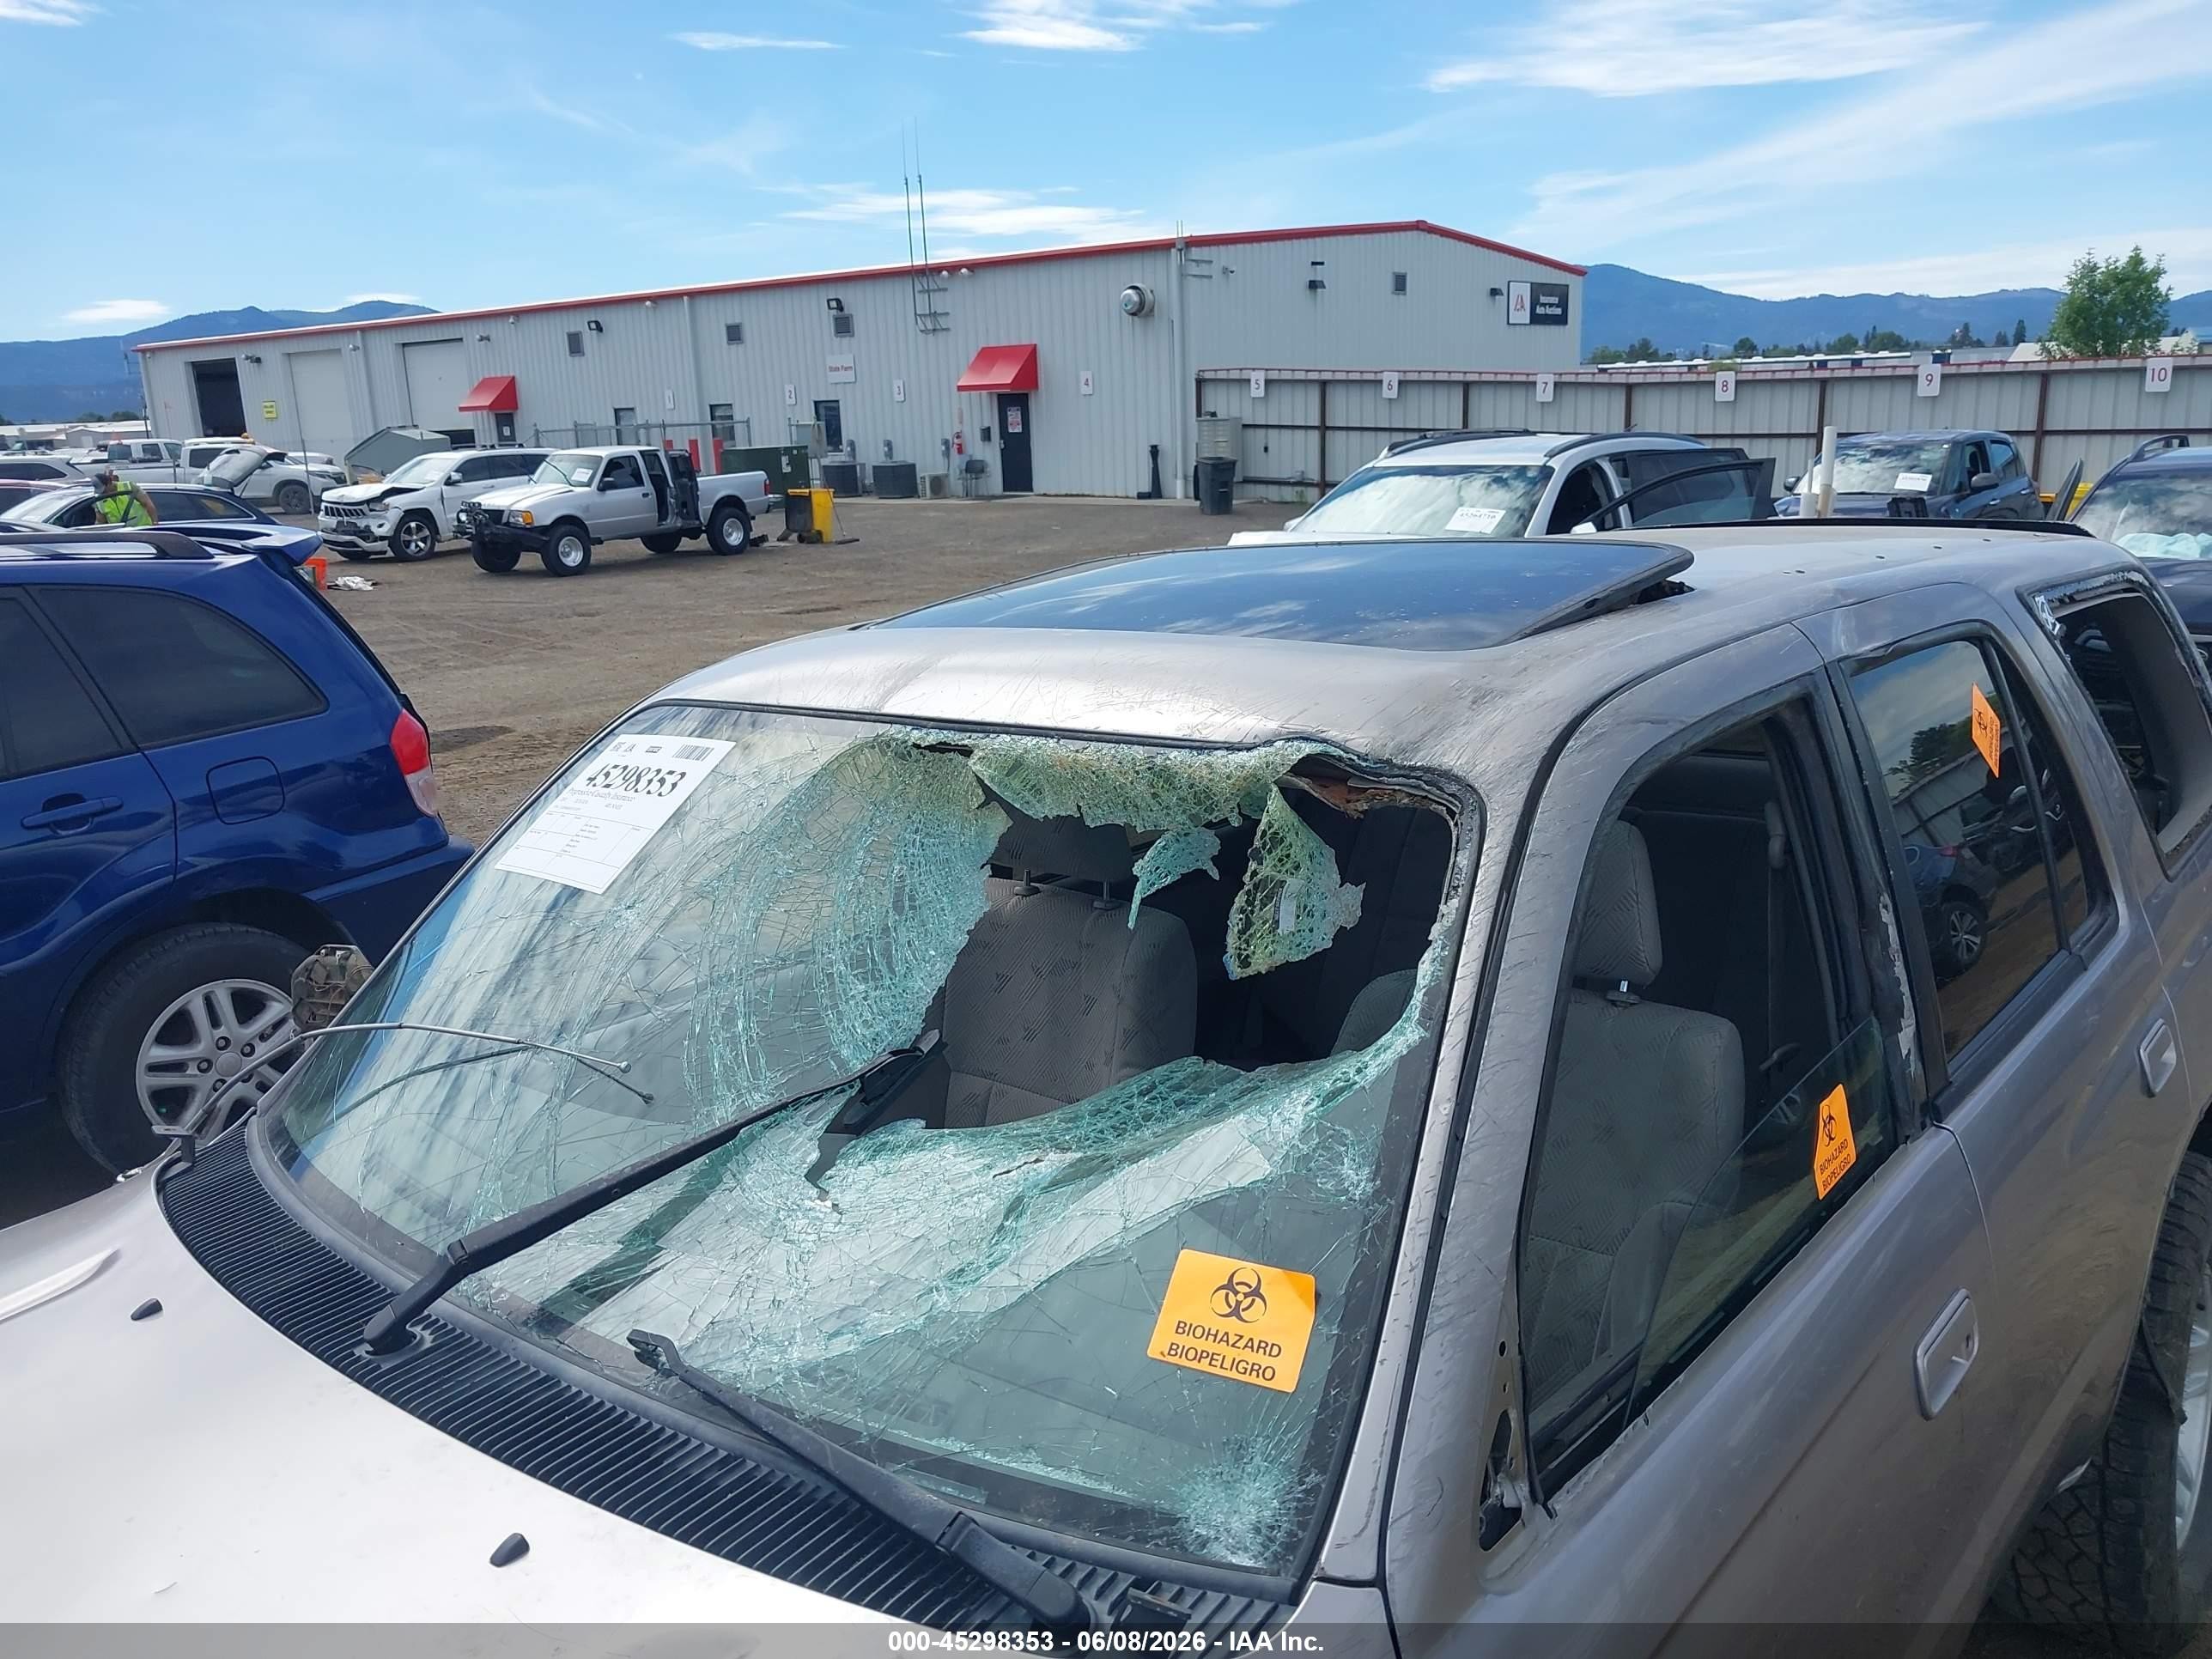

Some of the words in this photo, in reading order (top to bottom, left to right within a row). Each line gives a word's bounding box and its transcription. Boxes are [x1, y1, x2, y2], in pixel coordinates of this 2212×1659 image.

[1925, 373, 1934, 386] 9
[2150, 368, 2167, 382] 10
[1084, 377, 1090, 387] 4
[1255, 379, 1261, 390] 5
[1387, 380, 1393, 391] 6
[1541, 381, 1548, 394] 7
[1721, 380, 1729, 392] 8
[787, 389, 793, 399] 2
[896, 385, 902, 396] 3
[586, 763, 687, 797] 45298353
[1820, 1139, 1848, 1176] BIOHAZARD
[1822, 1153, 1850, 1191] BIOPELIGRO
[1175, 1320, 1282, 1358] BIOHAZARD
[1167, 1342, 1276, 1382] BIOPELIGRO
